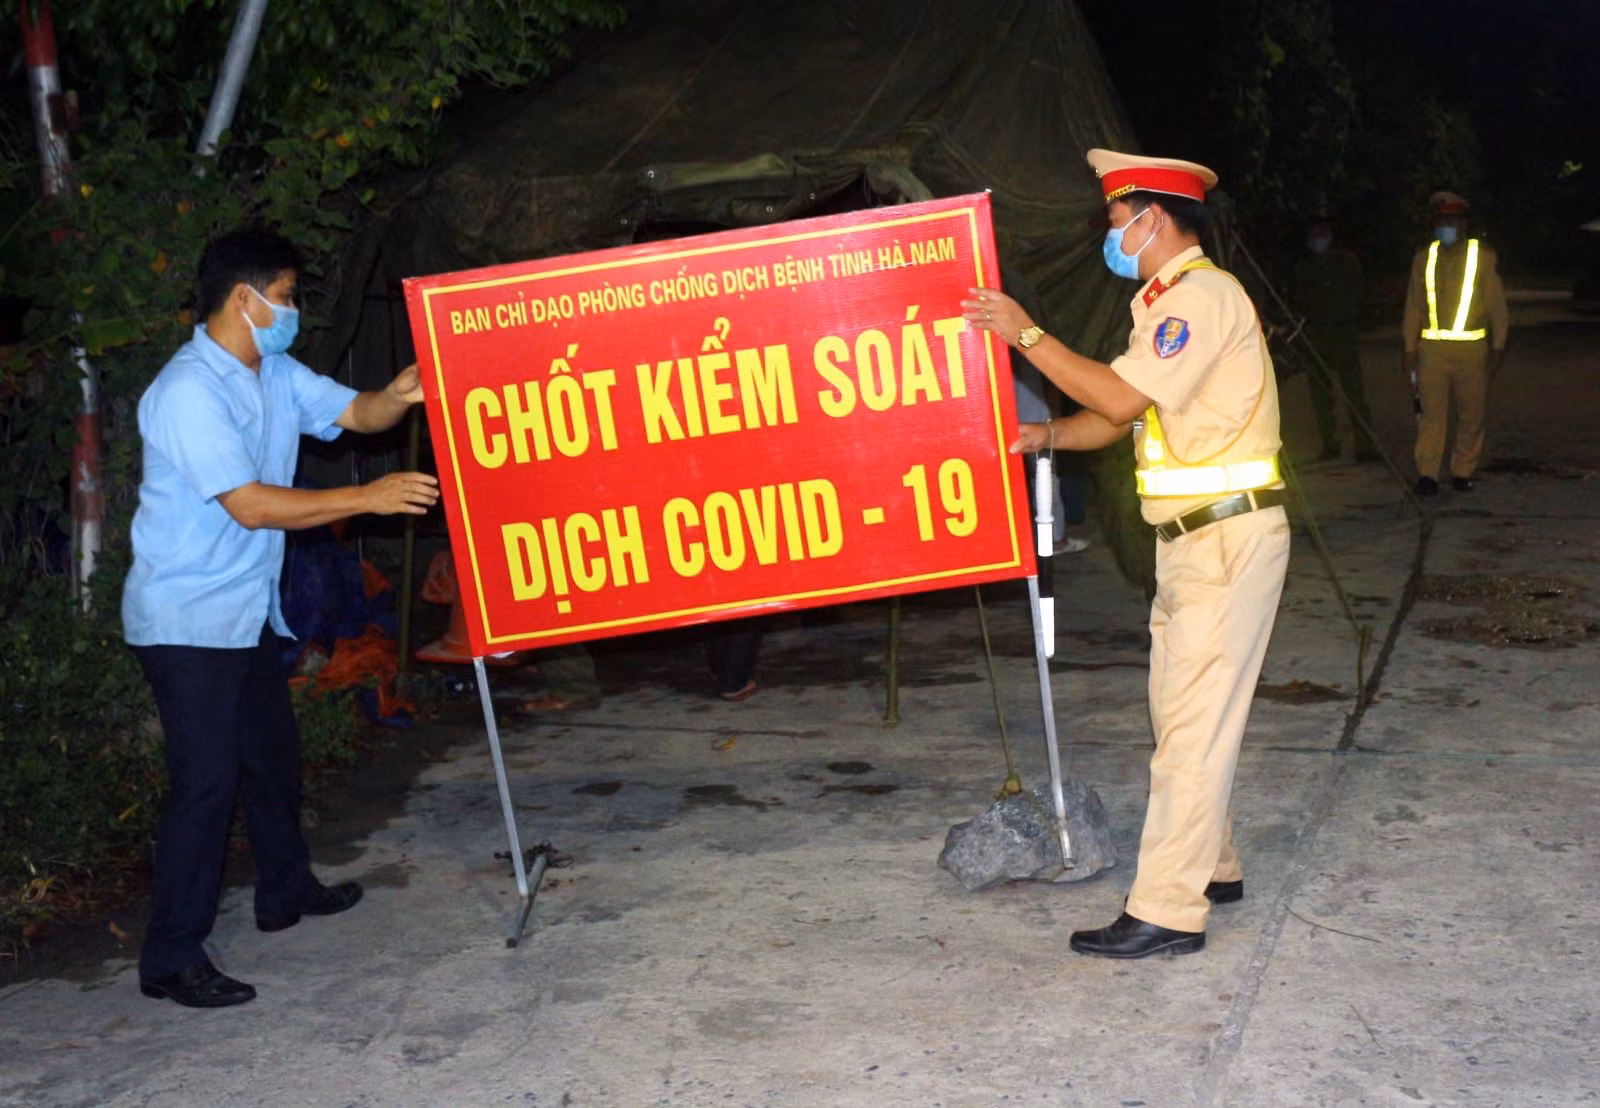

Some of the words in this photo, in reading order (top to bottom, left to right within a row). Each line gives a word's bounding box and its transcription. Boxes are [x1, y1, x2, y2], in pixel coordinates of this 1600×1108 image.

[450, 308, 493, 334] BAN
[496, 291, 528, 328] CHỈ
[531, 294, 574, 328] ĐẠO
[577, 281, 646, 316] PHÒNG
[650, 265, 719, 304] CHỐNG
[722, 265, 770, 300] DỊCH
[773, 256, 825, 292] BỆNH
[828, 243, 874, 278] TỈNH
[878, 239, 907, 270] HÀ
[910, 236, 956, 266] NAM
[465, 343, 619, 468] CHỐT
[634, 316, 798, 444] KIỂM
[812, 304, 968, 419] SOÁT
[500, 505, 650, 614] DỊCH
[662, 479, 844, 578] COVID
[863, 507, 884, 525] -
[901, 458, 979, 542] 19
